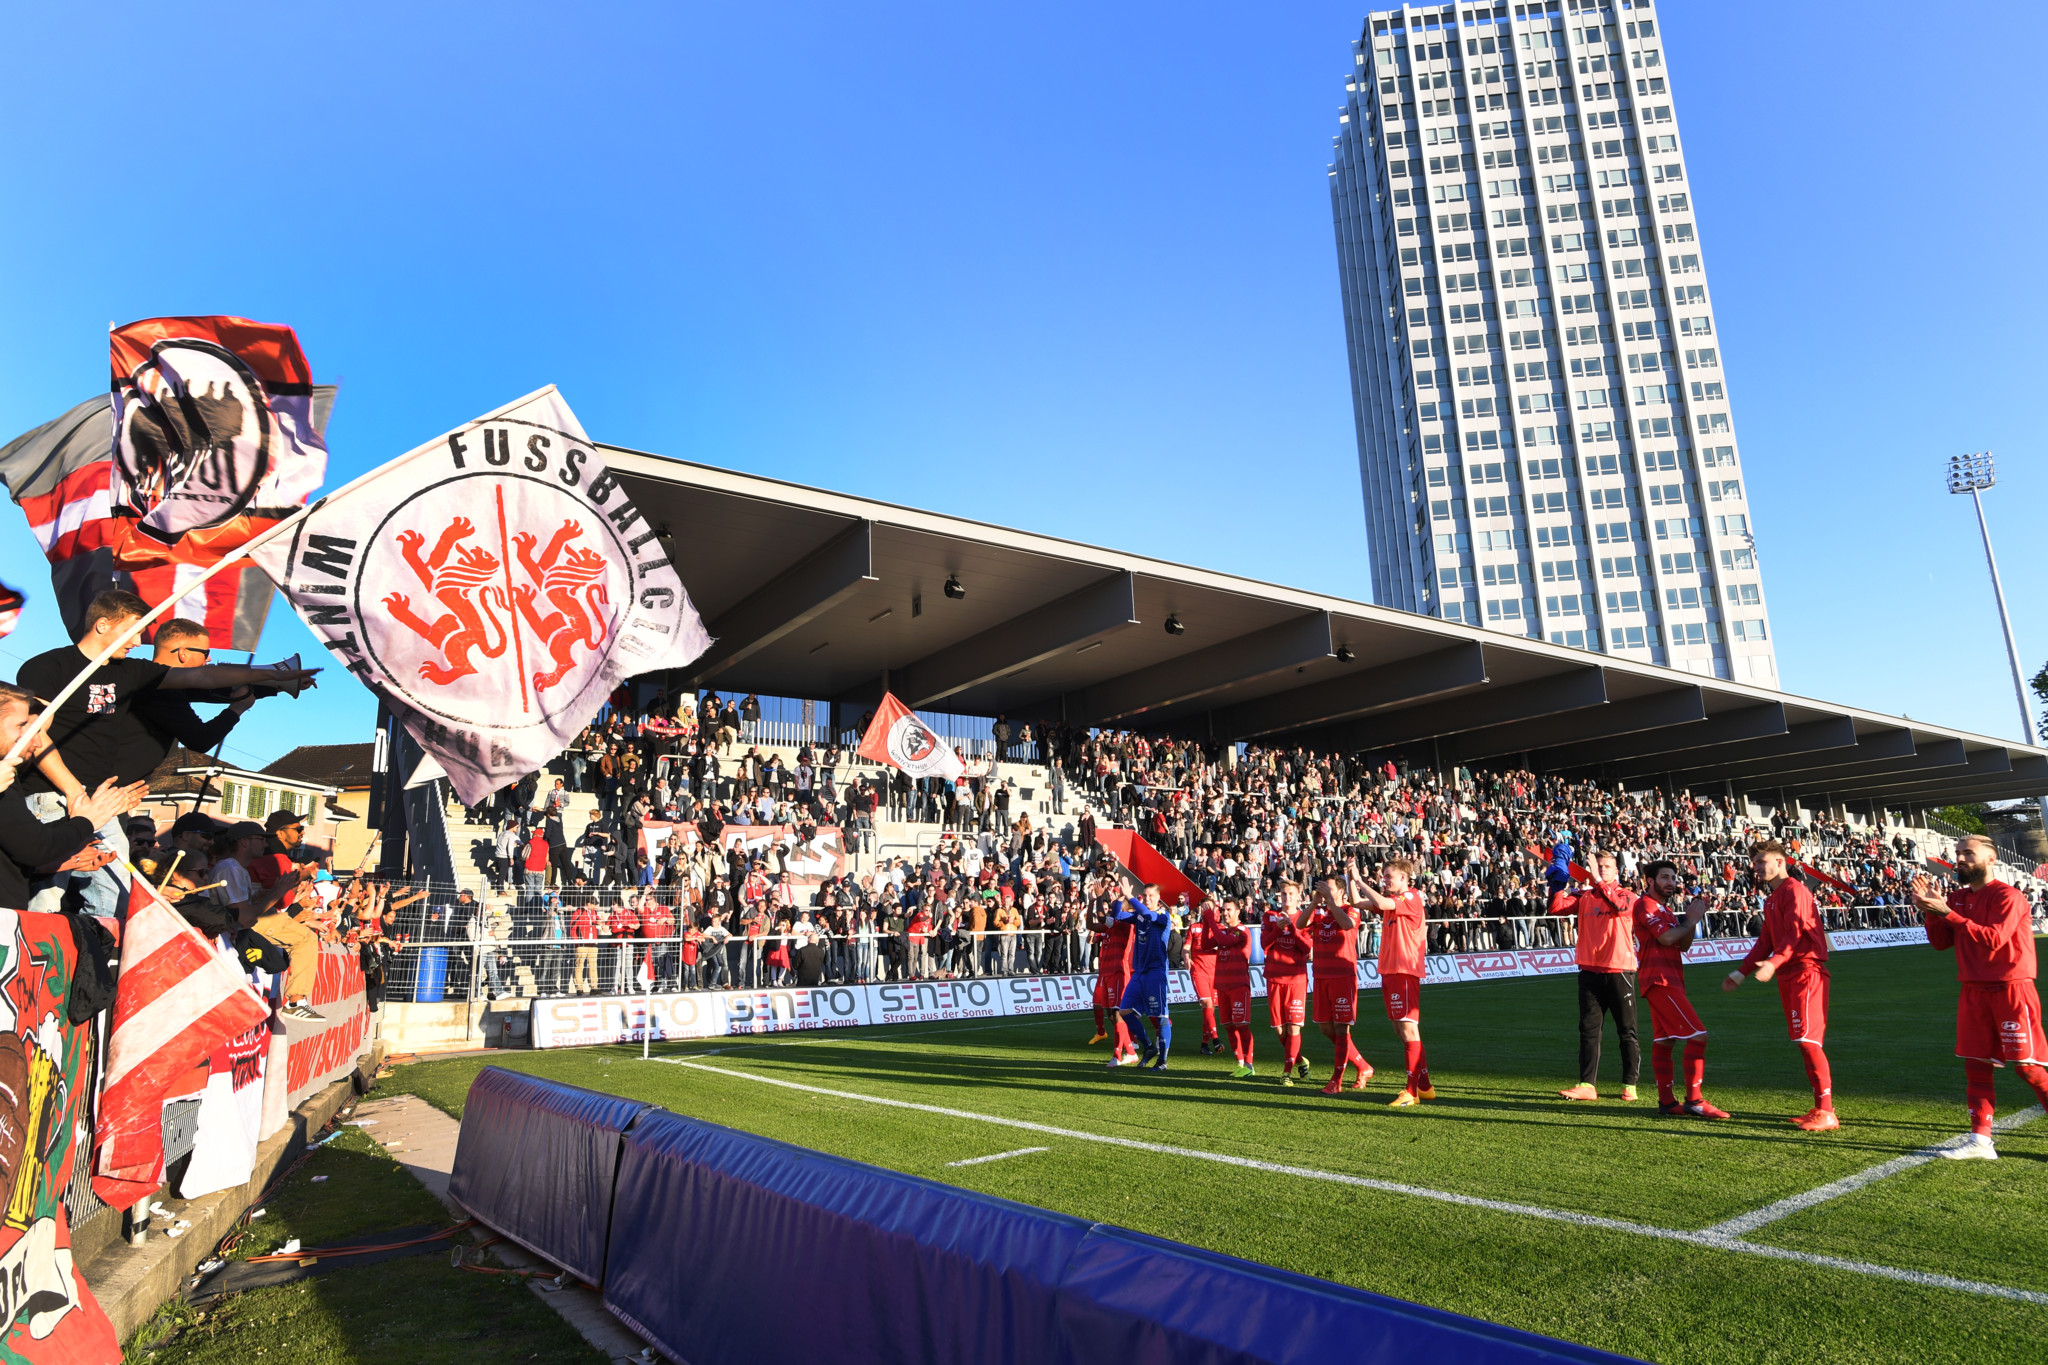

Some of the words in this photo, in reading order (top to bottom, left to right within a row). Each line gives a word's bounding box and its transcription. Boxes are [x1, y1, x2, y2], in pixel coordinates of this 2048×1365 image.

[299, 533, 513, 768] WINTETHUR
[1456, 952, 1518, 978] RIZZO
[1518, 949, 1574, 973] RIZZO
[1481, 970, 1520, 978] IMMOBILIEN
[727, 988, 856, 1023] SENERO
[880, 980, 990, 1012] SENERO
[1015, 1004, 1046, 1014] Strom
[1064, 1001, 1080, 1010] der
[551, 996, 699, 1034] SENERO
[730, 1022, 770, 1034] Strom
[773, 1022, 794, 1031] aus
[798, 1018, 820, 1029] der
[822, 1017, 859, 1028] Sonne
[883, 1012, 918, 1022] Strom
[920, 1012, 938, 1021] aus
[942, 1009, 959, 1019] der
[962, 1007, 994, 1017] Sonne
[552, 1035, 596, 1047] Strom
[602, 1033, 628, 1044] aus
[660, 1028, 701, 1040] Sonne
